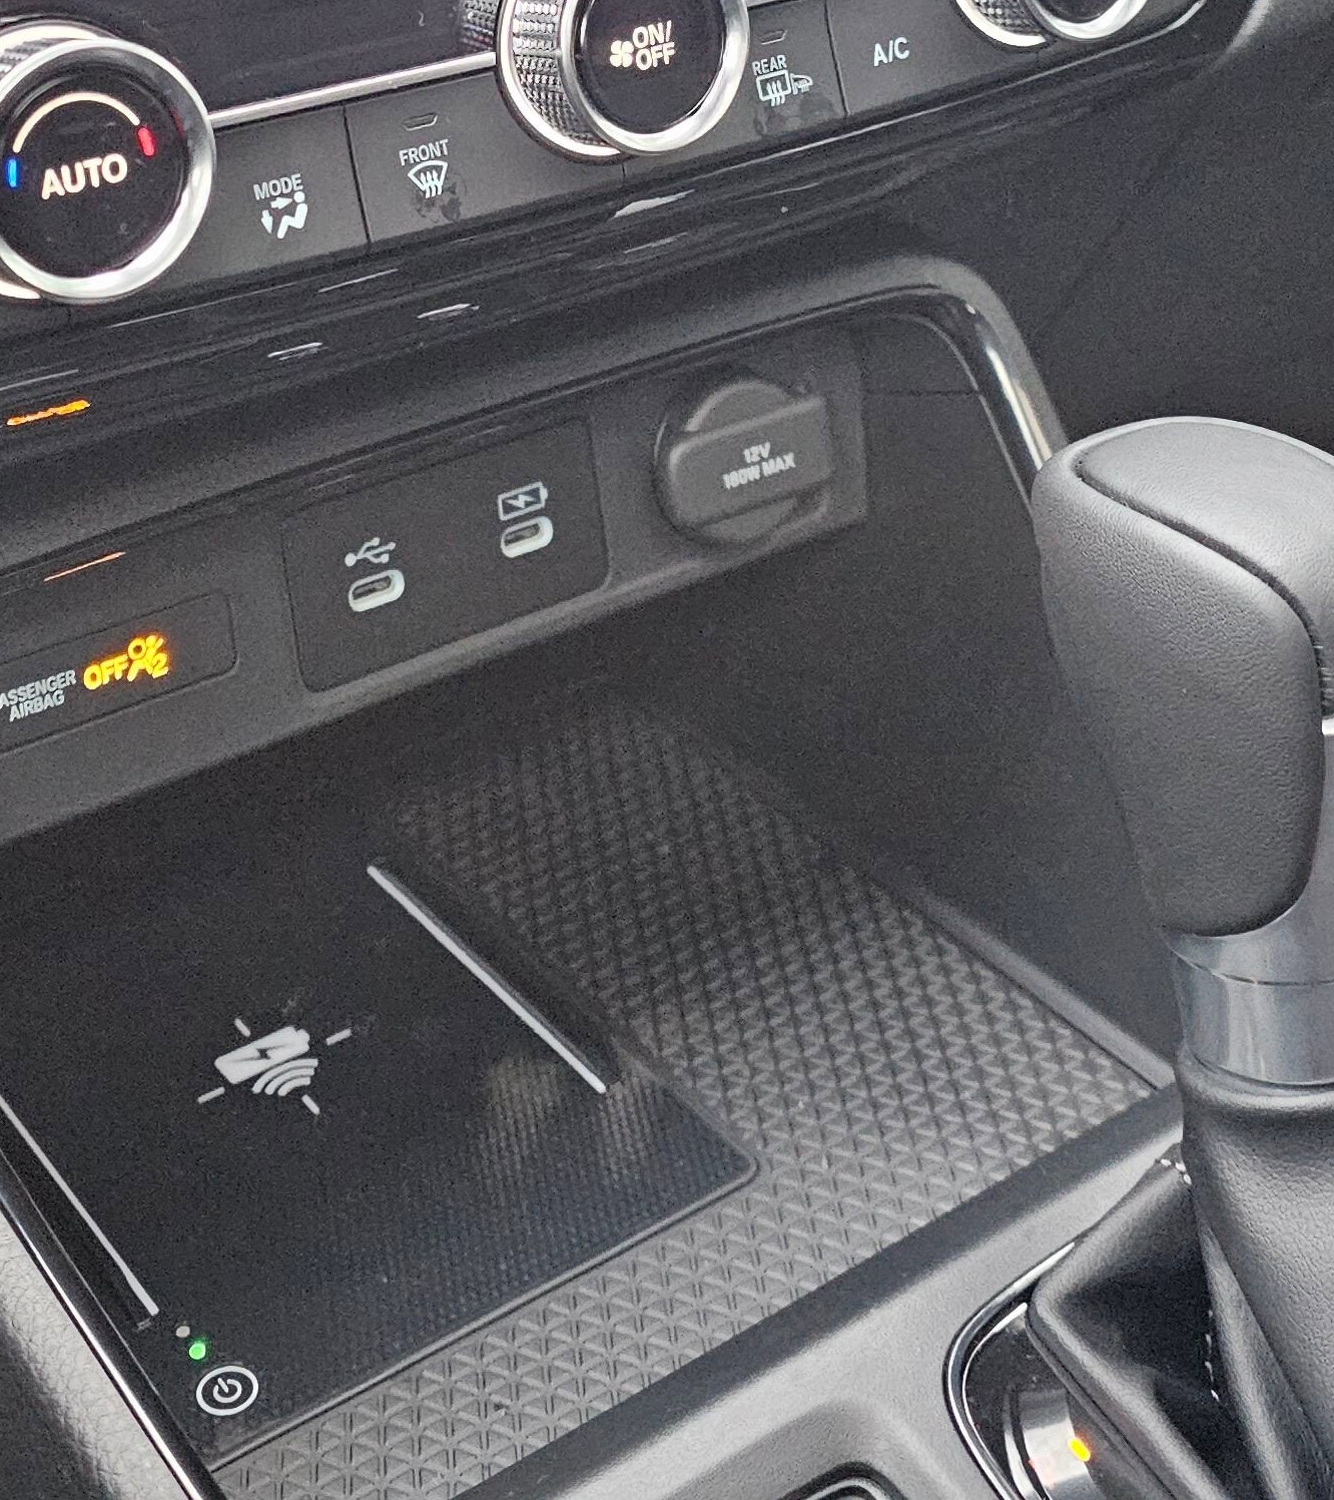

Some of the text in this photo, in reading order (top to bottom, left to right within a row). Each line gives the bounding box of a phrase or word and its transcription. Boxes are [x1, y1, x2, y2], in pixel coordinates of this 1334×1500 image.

[632, 21, 672, 49] ON/
[635, 42, 675, 72] OFF
[752, 54, 787, 74] REAR
[873, 37, 910, 67] A/C
[398, 139, 449, 166] FRONT
[40, 152, 128, 201] AUTO
[253, 173, 303, 200] MODE
[762, 452, 796, 476] MAX
[83, 654, 129, 690] OFF
[9, 690, 65, 722] AIRBAG
